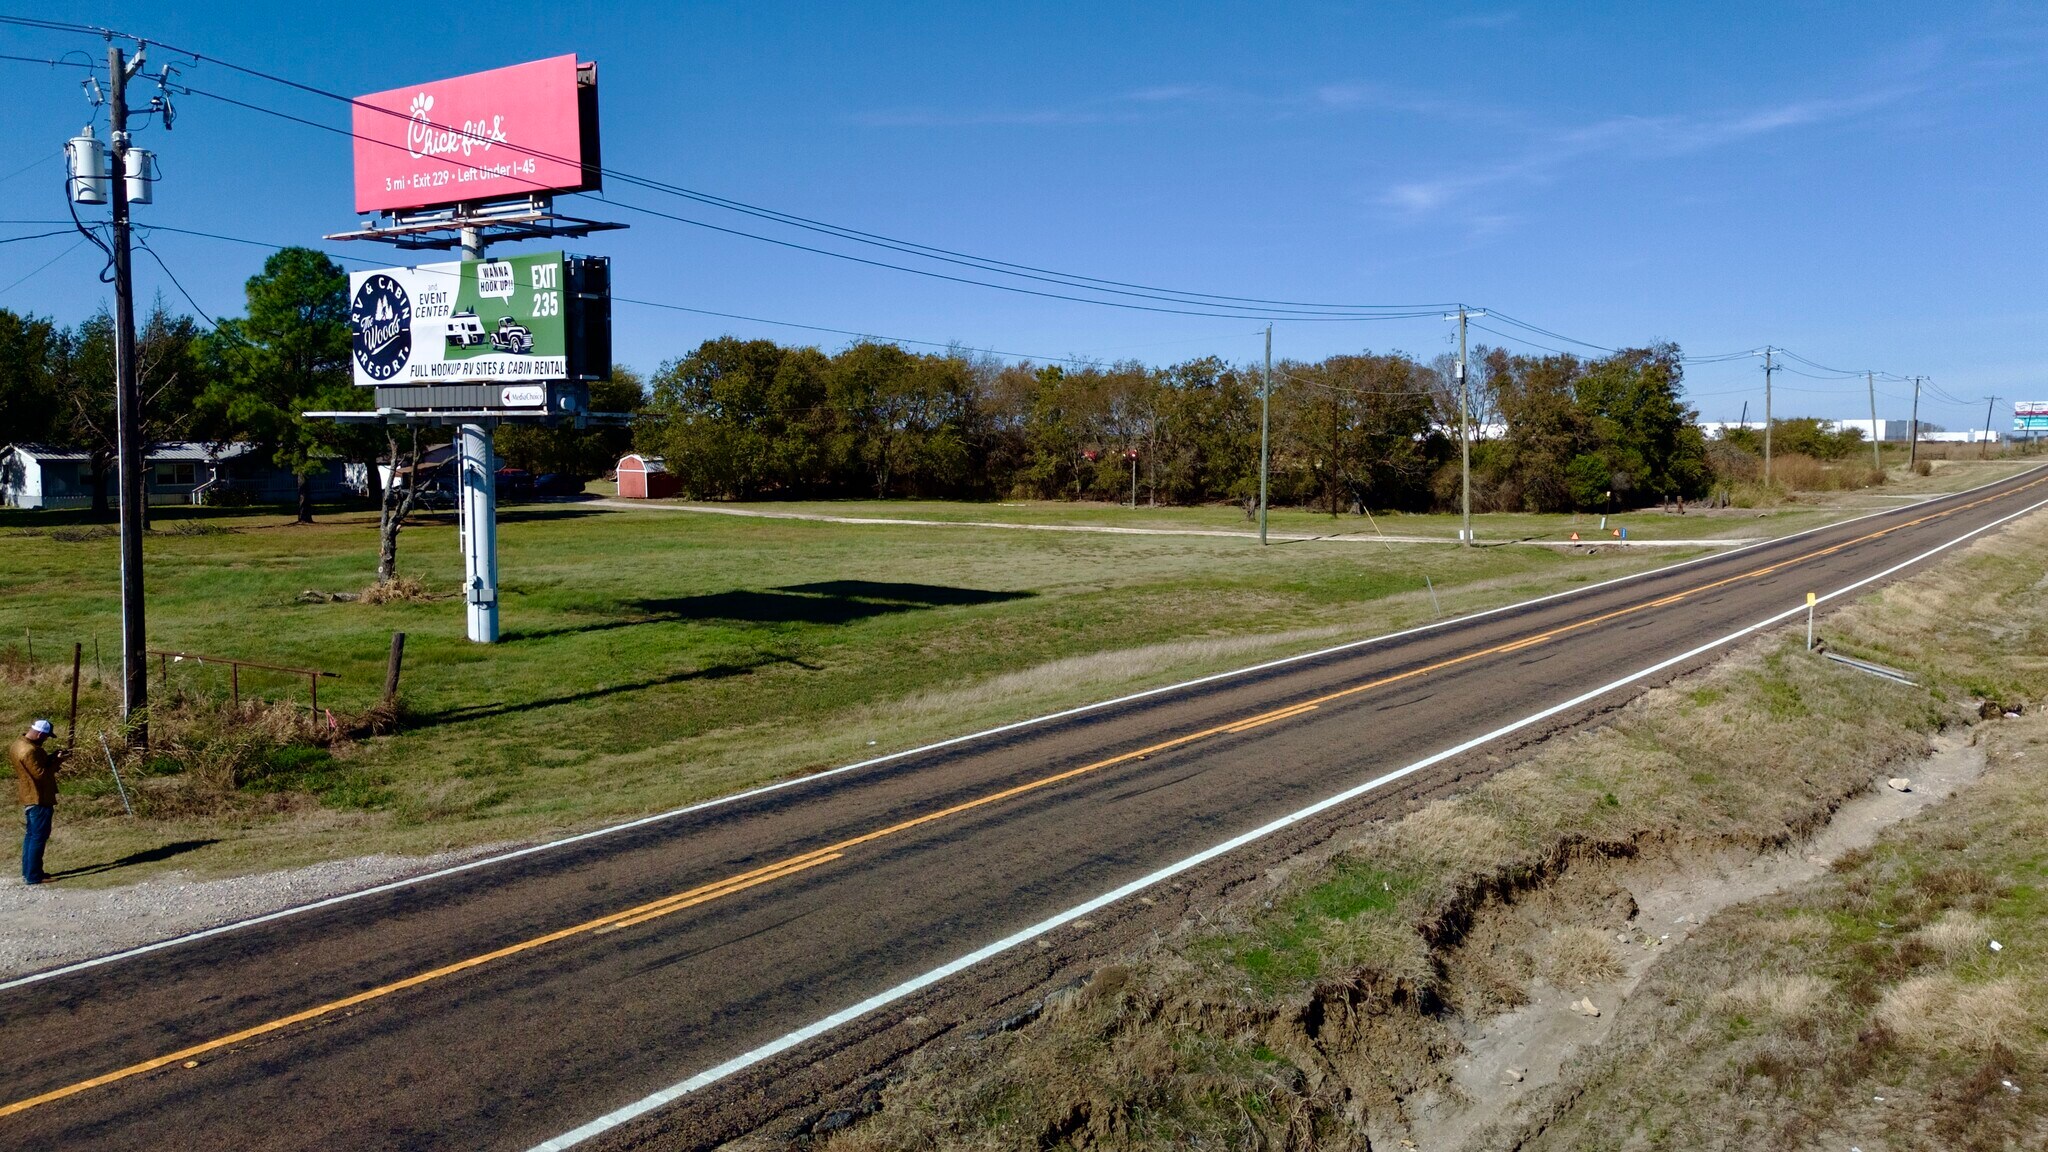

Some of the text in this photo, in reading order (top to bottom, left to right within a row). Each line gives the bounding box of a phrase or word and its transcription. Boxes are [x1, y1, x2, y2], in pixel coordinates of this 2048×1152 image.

[385, 158, 536, 191] 3 mi Exit 229 Left Under I-45
[482, 266, 509, 279] WANNA
[531, 263, 558, 289] EXIT
[480, 280, 498, 292] HOOK
[352, 277, 410, 323] RV & CABIN
[419, 292, 448, 305] EVENT
[532, 291, 558, 317] 235
[415, 305, 450, 318] CENTER
[360, 315, 374, 333] The
[364, 313, 401, 351] Woods
[360, 351, 407, 377] RESORT
[410, 364, 429, 377] FULL
[431, 363, 462, 377] HOOKUP
[462, 362, 475, 375] RV
[476, 361, 498, 375] SITES
[499, 361, 505, 375] &
[507, 361, 533, 375] CABIN
